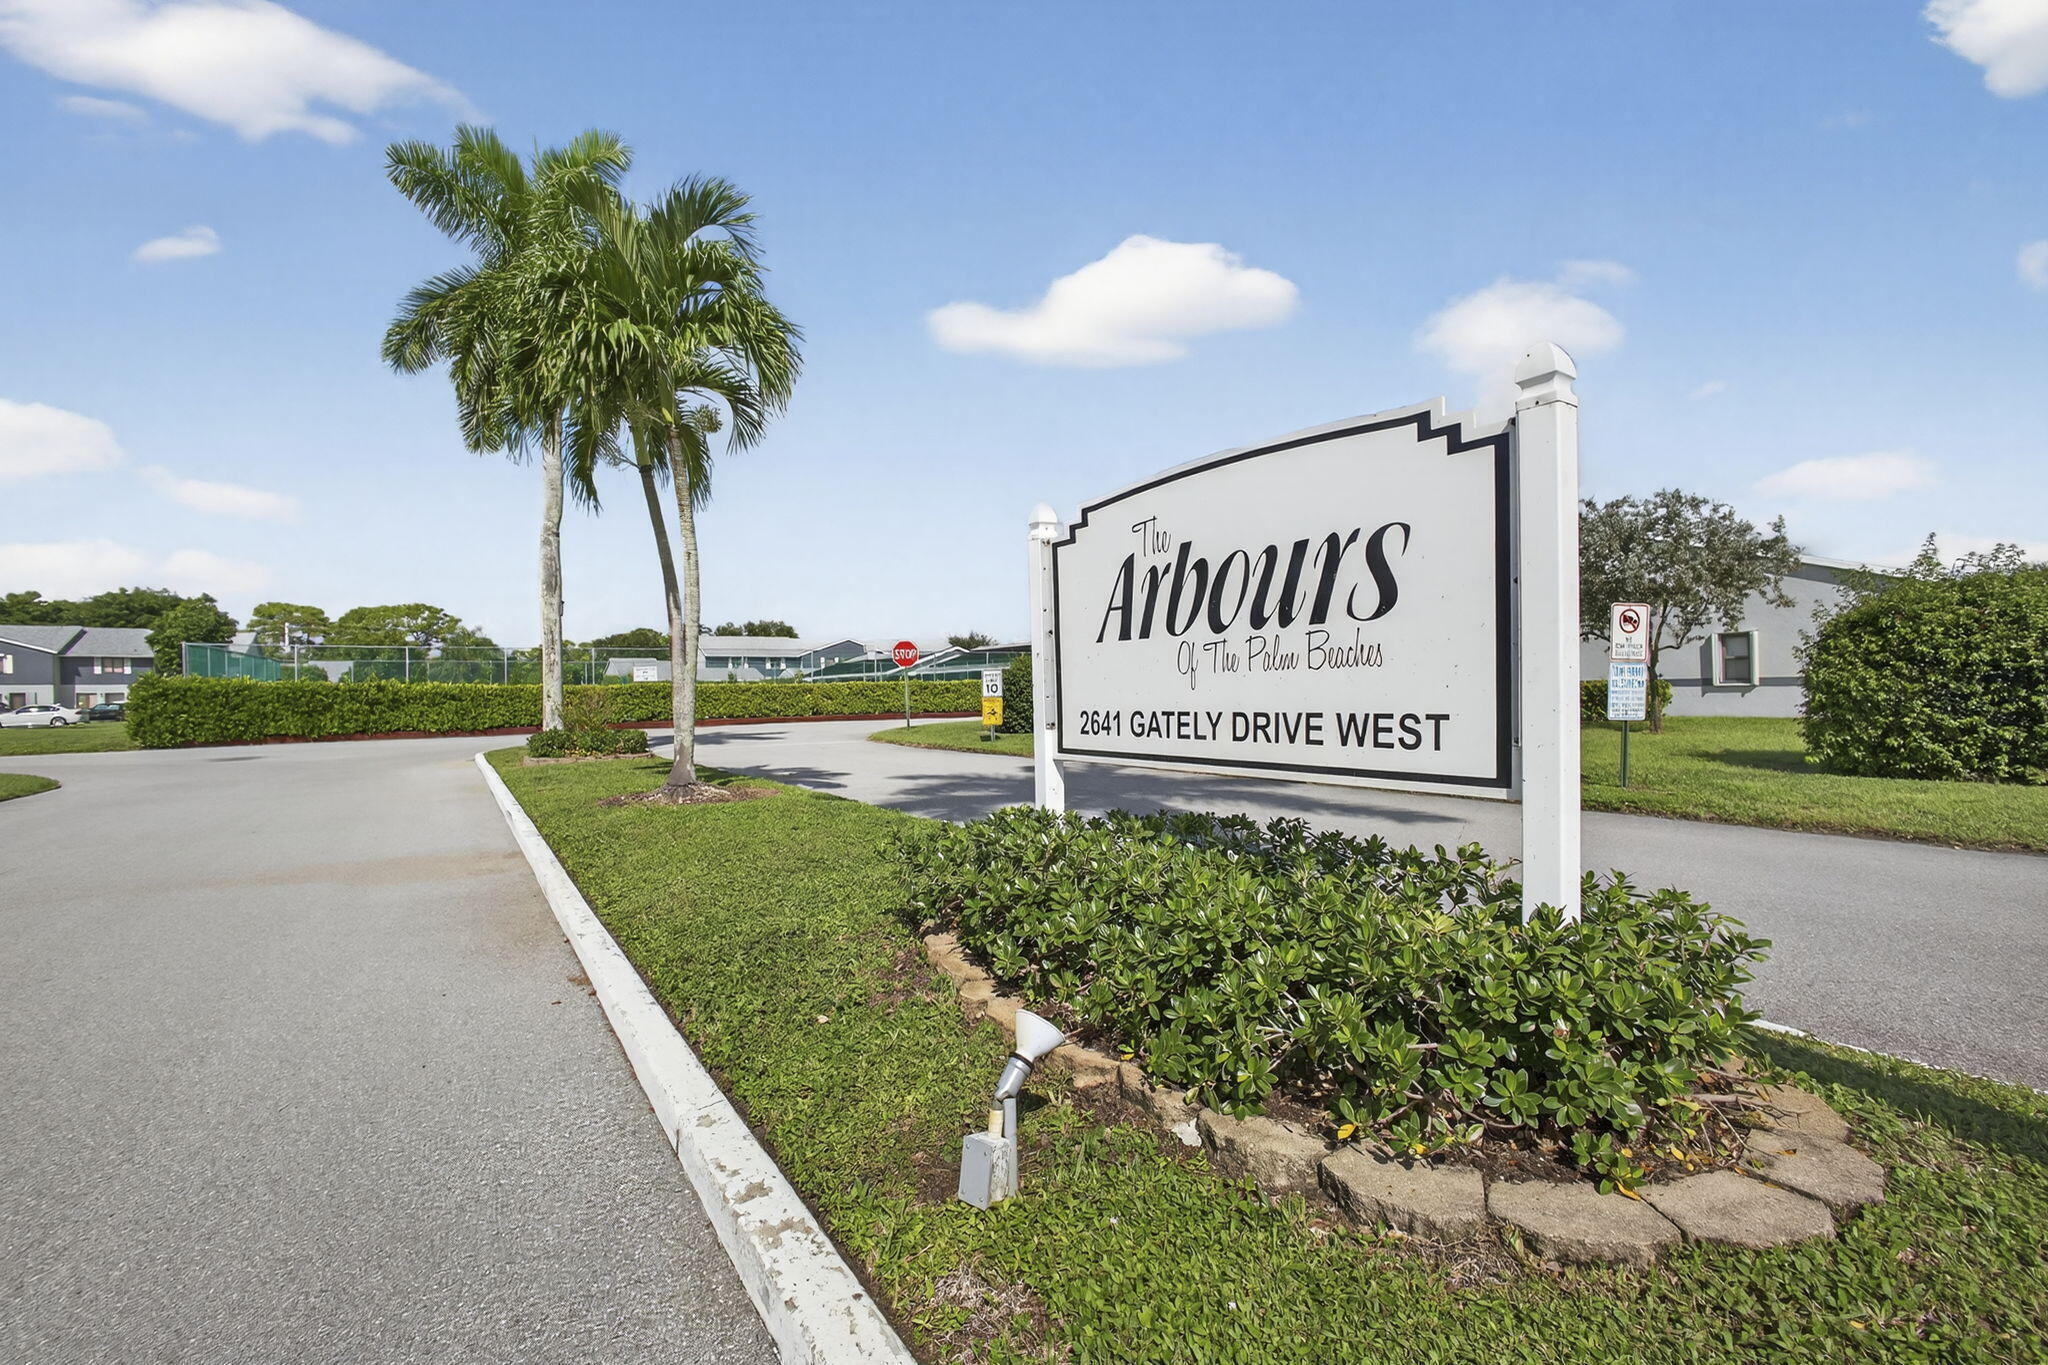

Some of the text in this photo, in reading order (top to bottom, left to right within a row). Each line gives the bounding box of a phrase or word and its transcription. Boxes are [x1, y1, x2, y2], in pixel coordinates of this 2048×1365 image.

[1131, 515, 1171, 558] The
[1096, 522, 1411, 643] Arbours
[895, 648, 917, 660] STOP
[1177, 627, 1384, 691] Of The Palm Beaches
[986, 683, 999, 694] 10
[1080, 710, 1451, 752] 2641 GATELY DRIVE WEST
